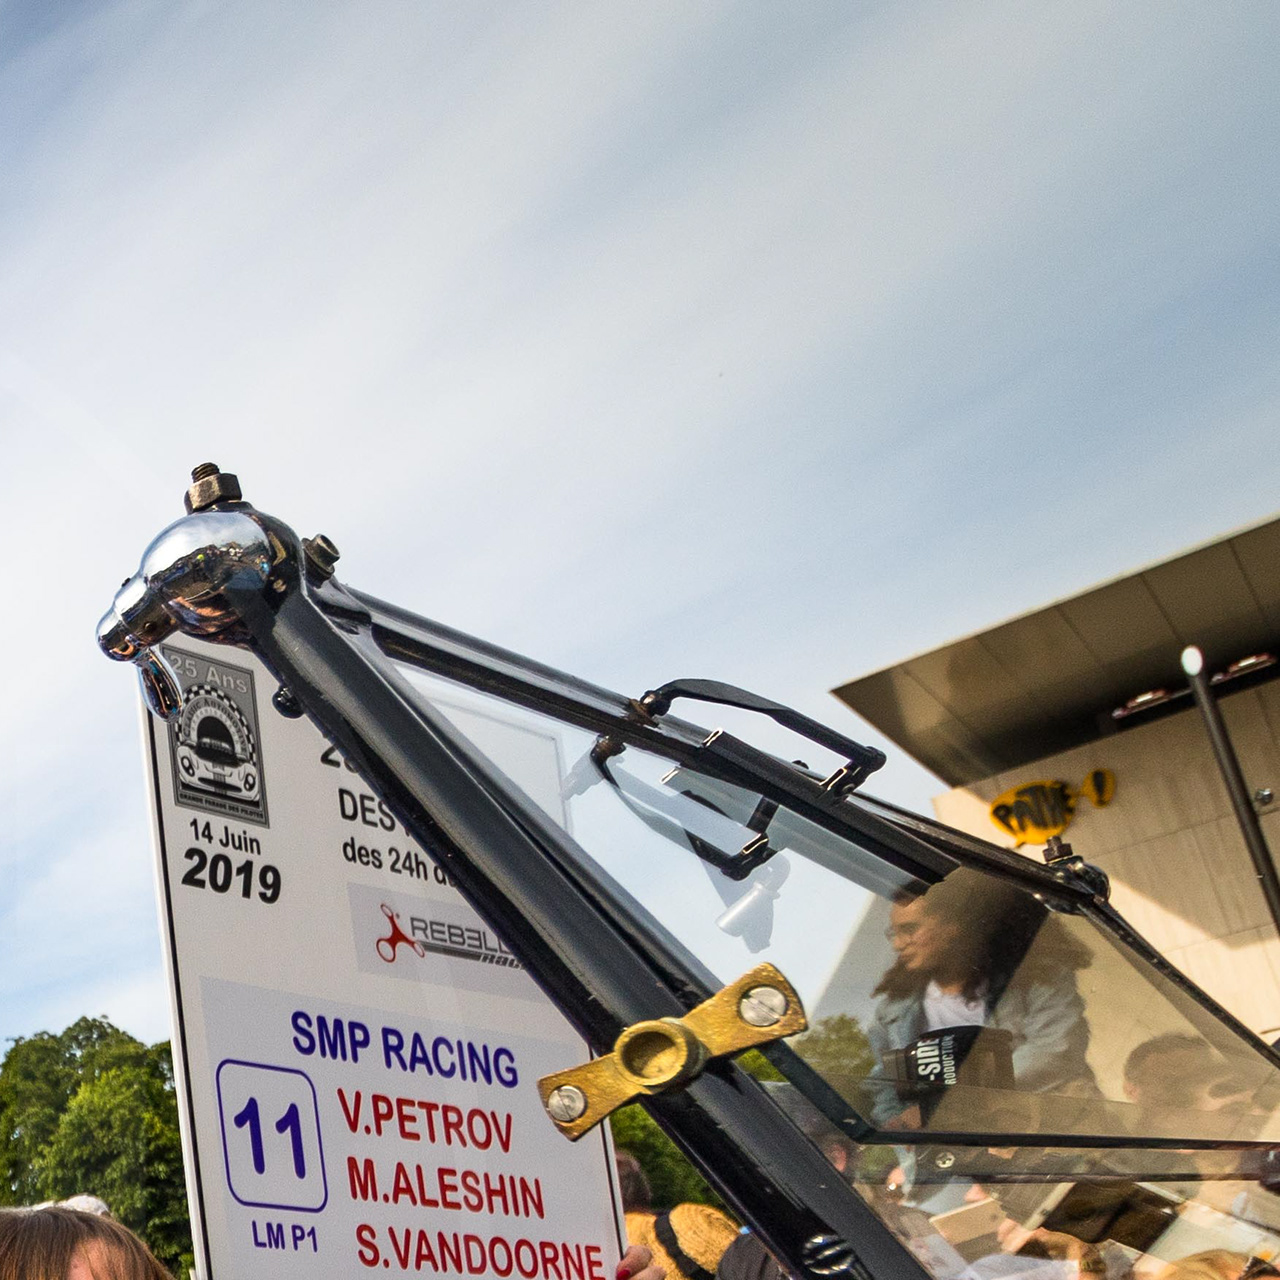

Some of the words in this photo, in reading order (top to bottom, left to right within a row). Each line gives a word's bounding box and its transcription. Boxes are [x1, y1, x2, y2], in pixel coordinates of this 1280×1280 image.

[169, 655, 198, 679] 25
[206, 667, 248, 694] Ans
[188, 817, 214, 846] 14
[218, 822, 261, 857] Juin
[342, 836, 383, 869] des
[388, 846, 429, 882] 24h
[181, 846, 282, 904] 2019
[290, 1009, 371, 1064] SMP
[380, 1026, 520, 1089] RACING
[233, 1096, 306, 1180] 11
[336, 1087, 514, 1155] V.PETROV
[346, 1156, 546, 1220] M.ALESHIN
[251, 1219, 287, 1251] LM
[291, 1223, 319, 1253] P1
